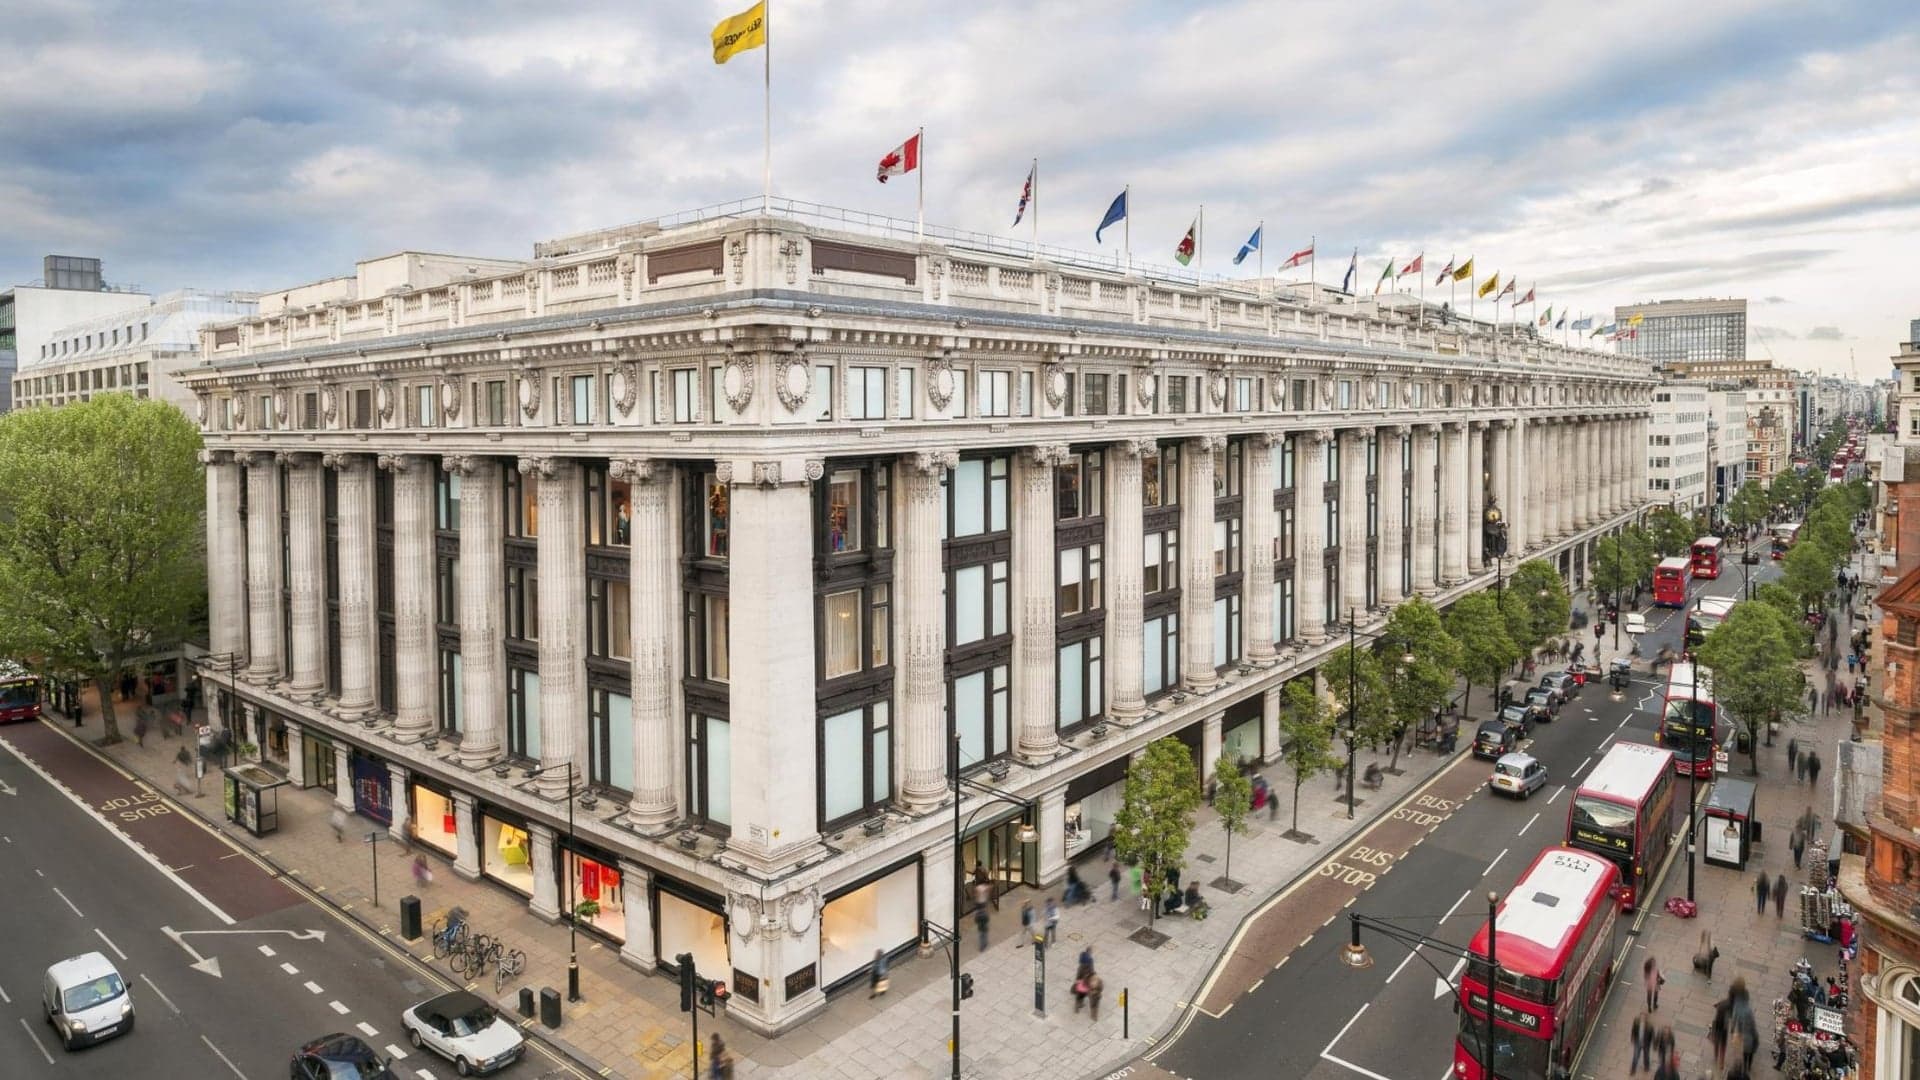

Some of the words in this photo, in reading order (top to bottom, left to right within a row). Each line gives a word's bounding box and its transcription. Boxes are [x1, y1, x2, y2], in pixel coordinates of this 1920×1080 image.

[1696, 727, 1705, 736] 73
[101, 792, 160, 811] STOP
[1416, 794, 1454, 811] BUS
[120, 804, 171, 821] BUS
[1393, 808, 1441, 826] STOP
[1615, 838, 1628, 849] 94
[1350, 846, 1394, 866] BUS
[1320, 862, 1376, 886] STOP
[1520, 1012, 1536, 1026] 390
